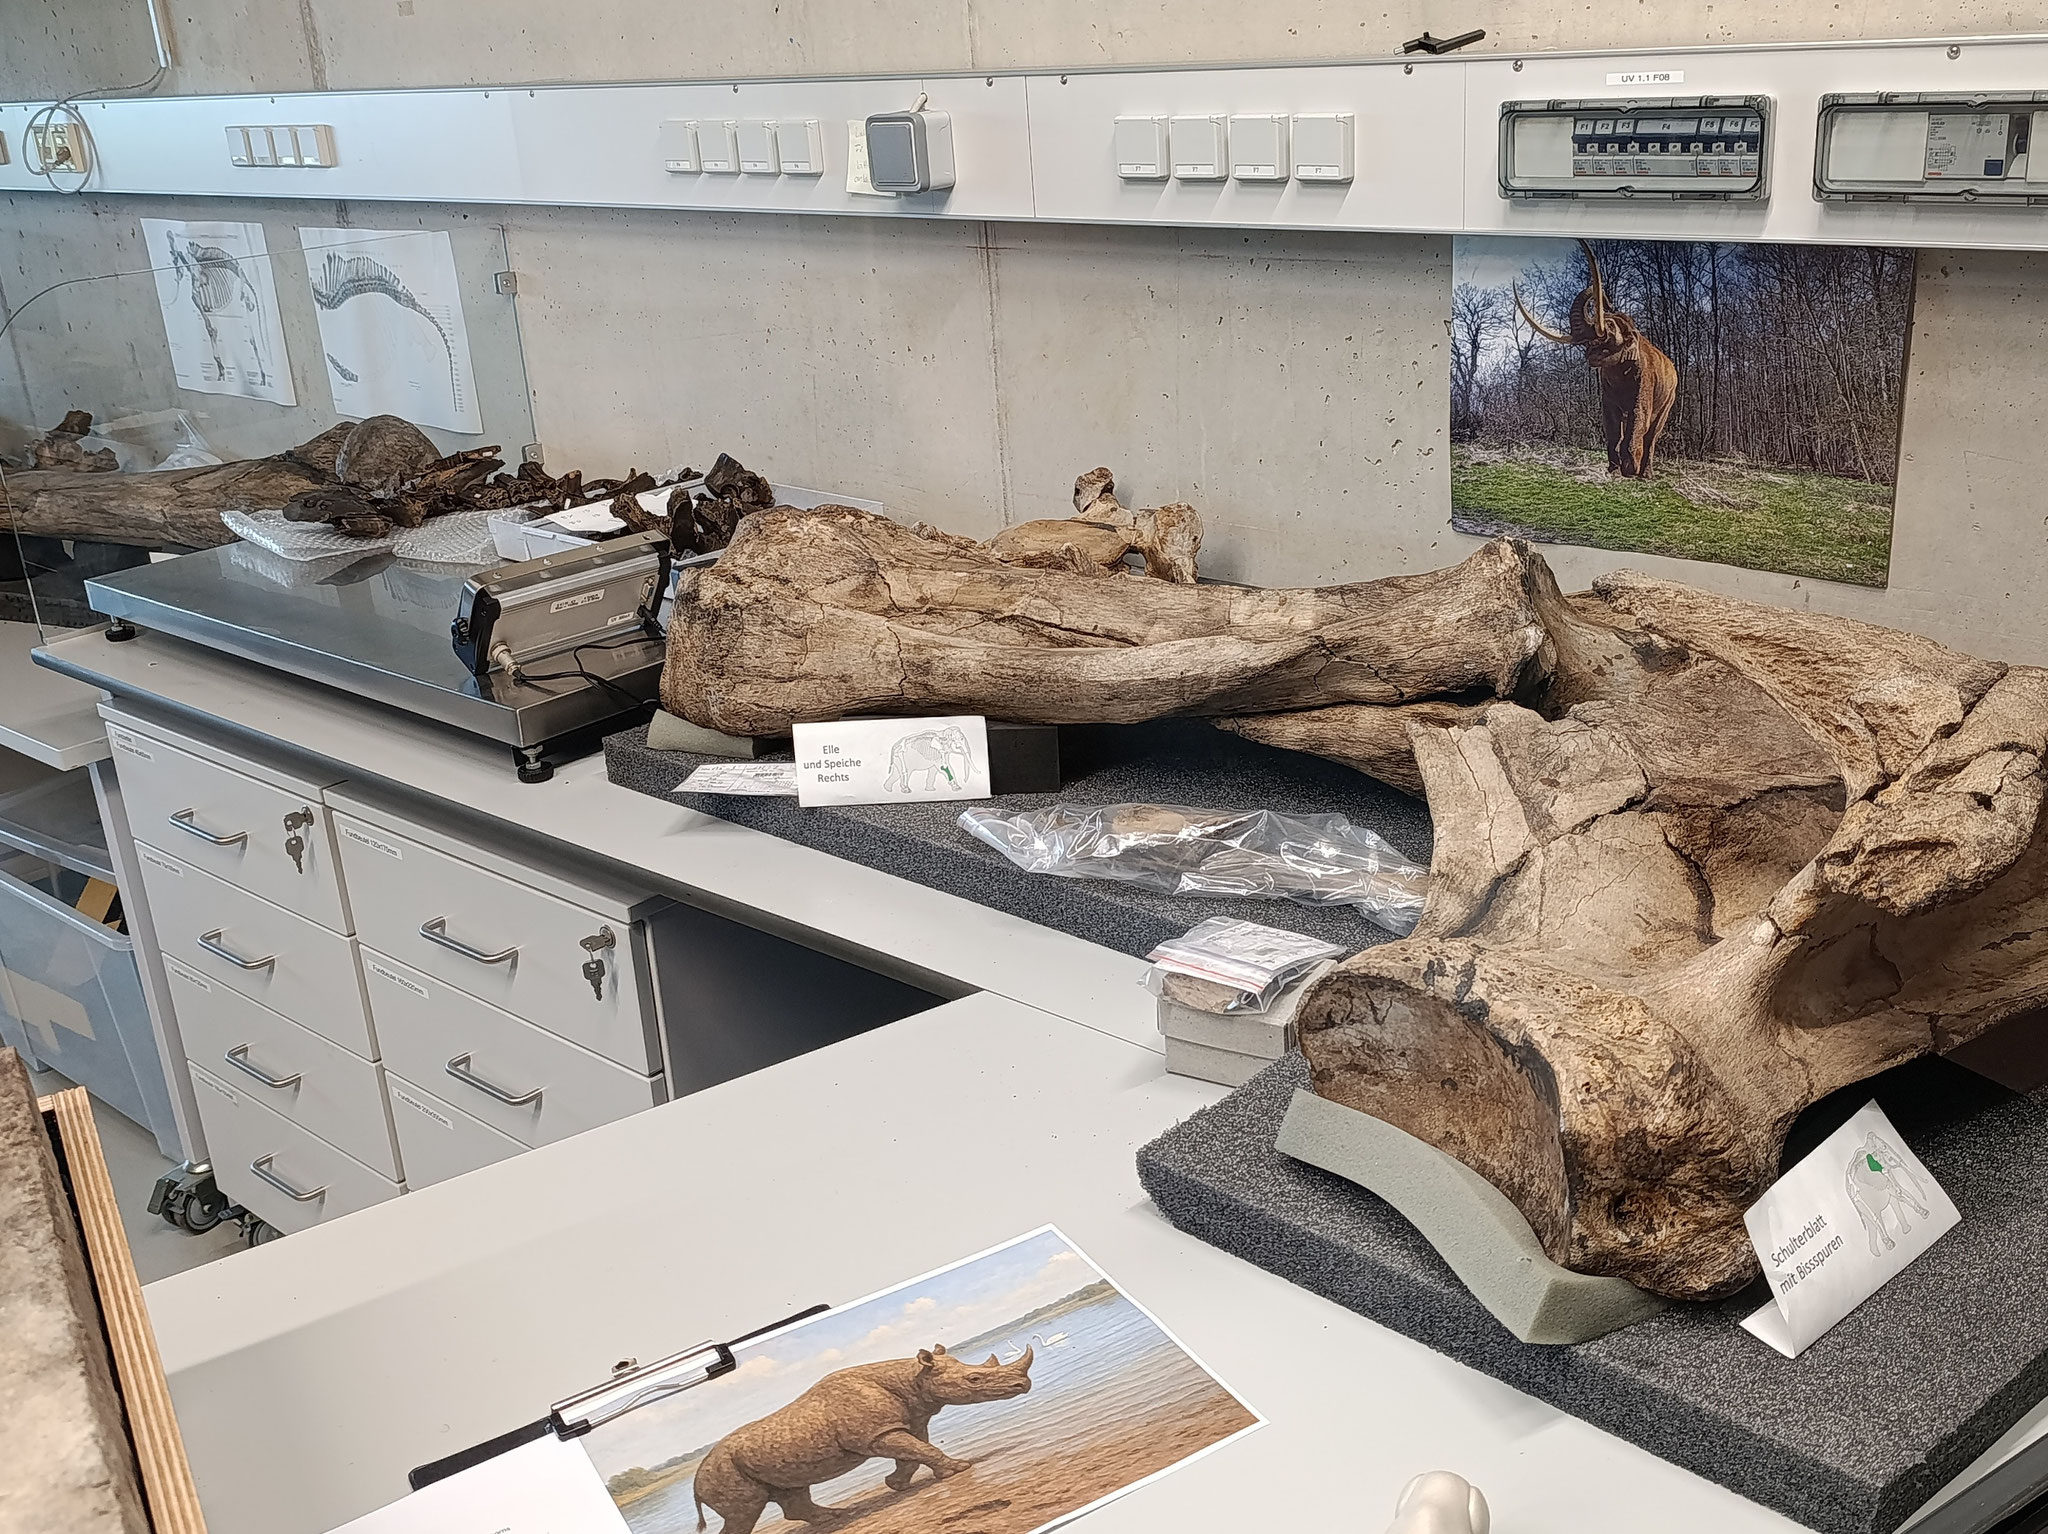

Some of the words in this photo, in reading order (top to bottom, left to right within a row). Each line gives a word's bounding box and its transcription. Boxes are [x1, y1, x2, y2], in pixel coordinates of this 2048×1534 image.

[1621, 74, 1635, 83] UV
[1638, 74, 1650, 82] 1.1
[1653, 73, 1670, 82] F08
[1661, 123, 1671, 131] F4
[1704, 120, 1715, 128] F5
[1729, 120, 1739, 128] F6
[822, 744, 840, 755] Elle
[803, 759, 822, 770] und
[824, 757, 862, 770] Speiche
[817, 772, 850, 783] Rechts
[1770, 1213, 1828, 1268] Schulterblatt
[1779, 1272, 1799, 1295] mit
[1795, 1234, 1844, 1281] Bissspuren
